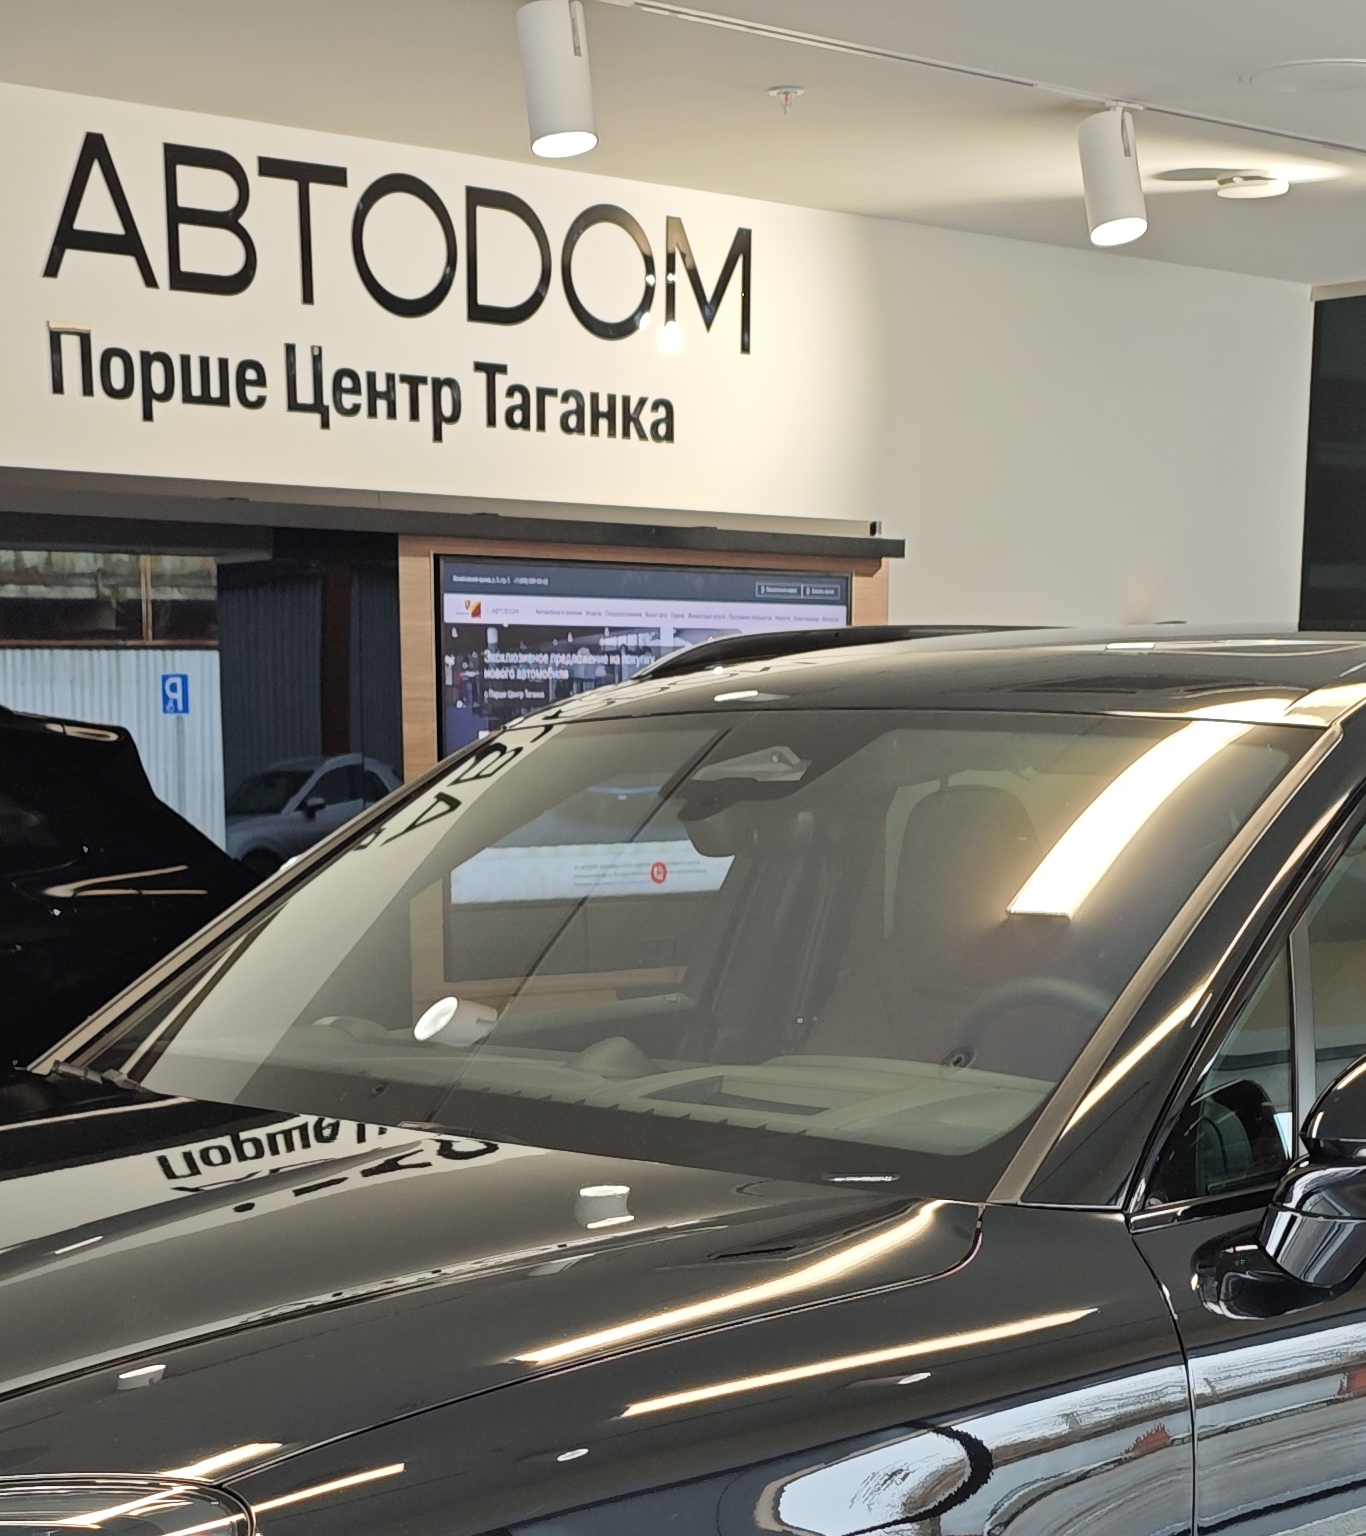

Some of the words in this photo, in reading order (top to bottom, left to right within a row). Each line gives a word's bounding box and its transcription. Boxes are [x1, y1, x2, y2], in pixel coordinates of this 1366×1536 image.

[47, 321, 268, 422] Порше
[284, 343, 462, 443] Центр
[473, 361, 676, 444] Таганка
